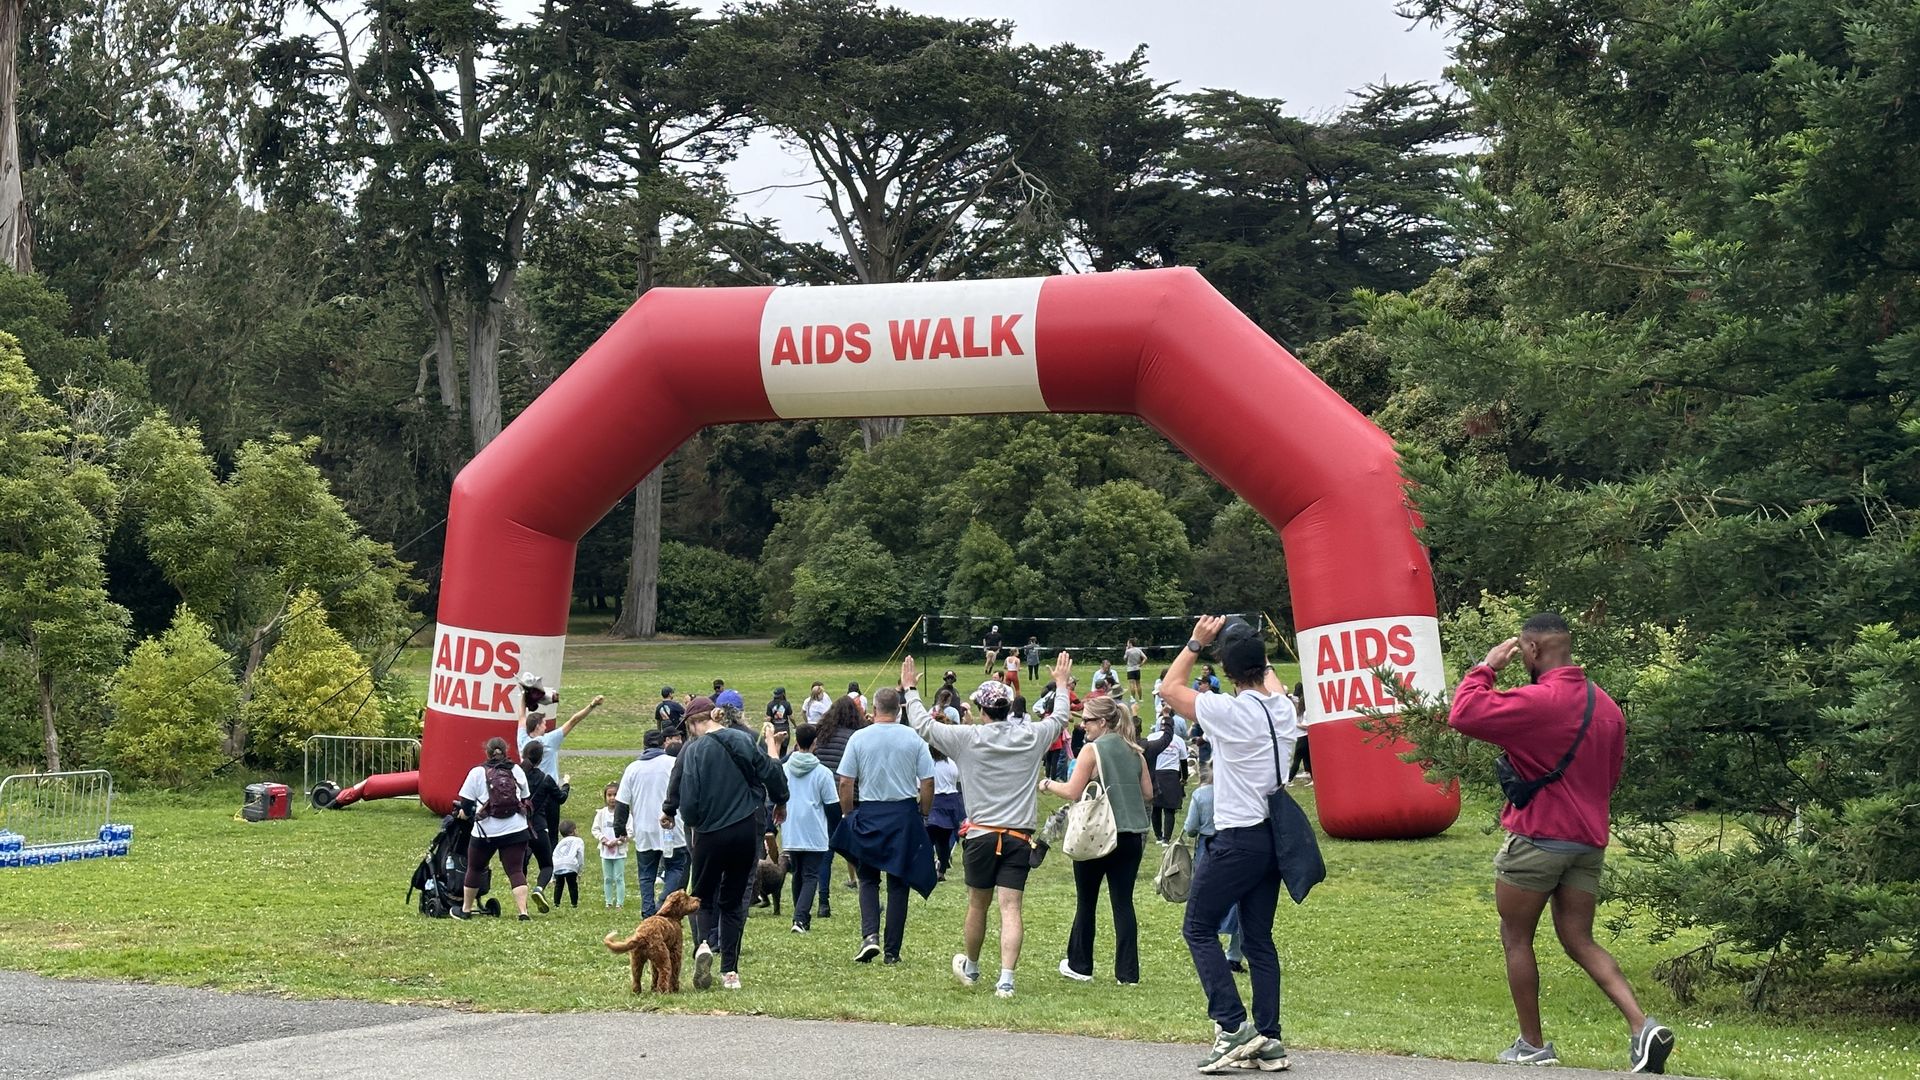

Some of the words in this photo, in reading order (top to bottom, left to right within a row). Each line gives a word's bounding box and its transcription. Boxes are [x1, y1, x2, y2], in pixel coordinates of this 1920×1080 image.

[771, 323, 872, 366] AIDS
[889, 314, 1024, 361] WALK
[435, 633, 521, 679] AIDS
[1316, 624, 1416, 677] AIDS
[433, 673, 517, 714] WALK
